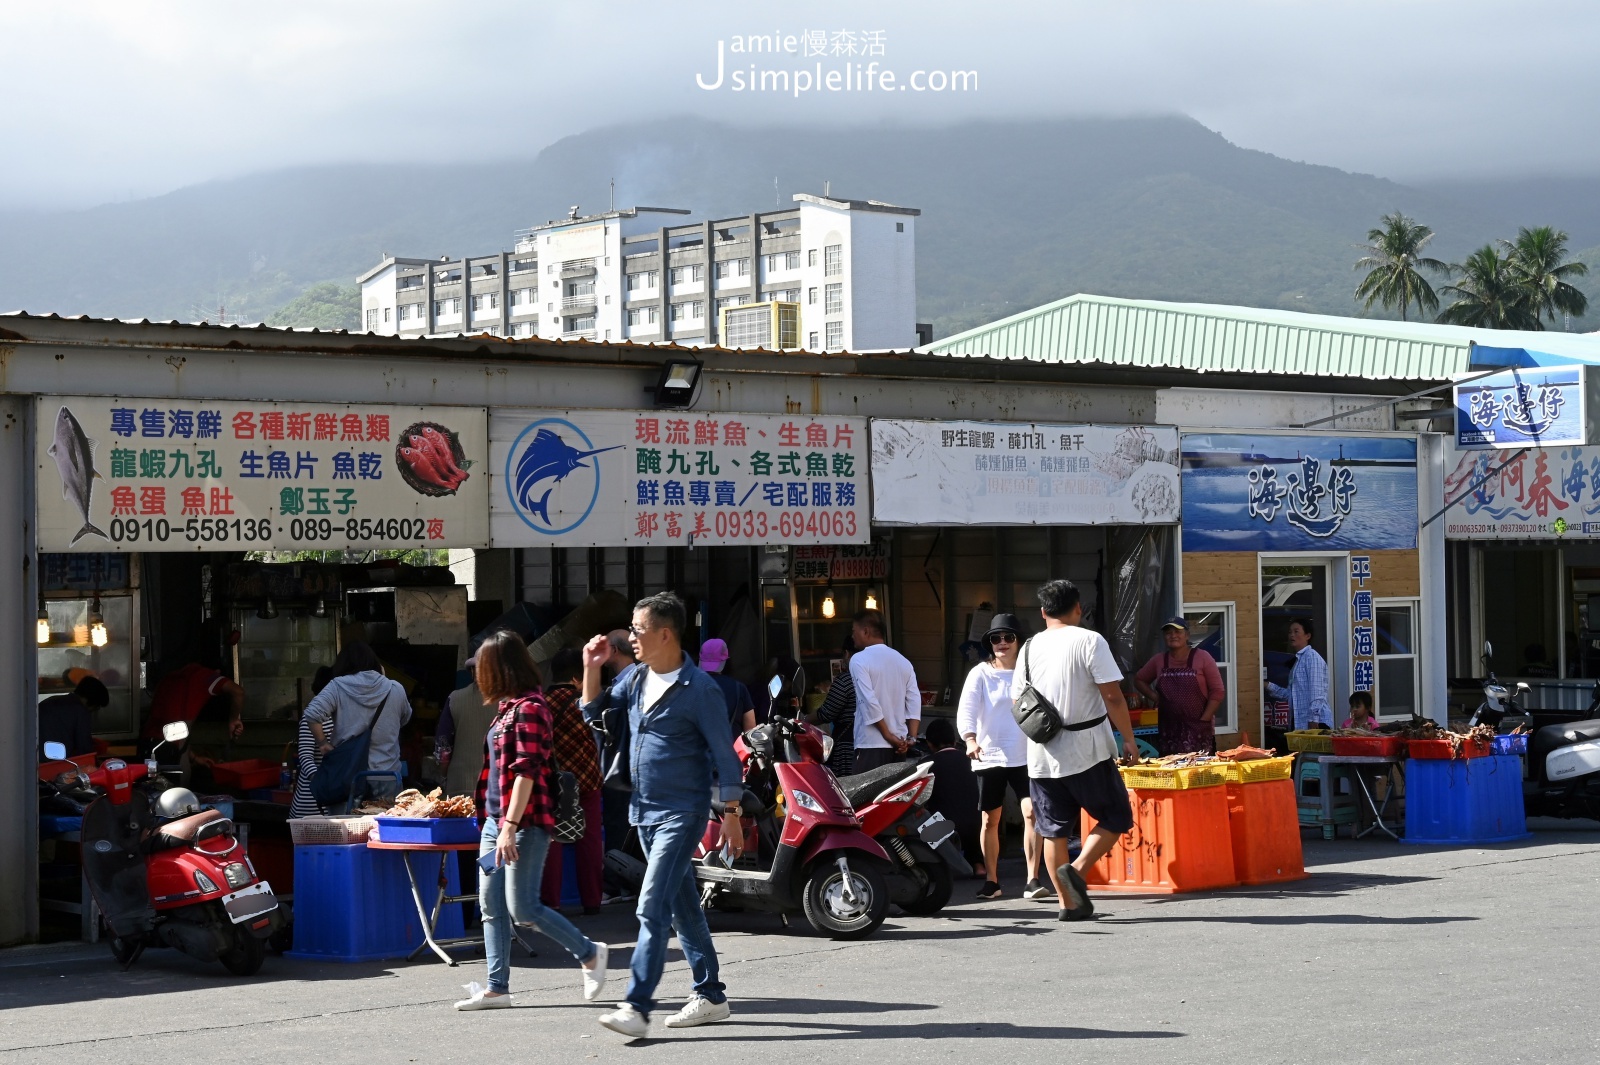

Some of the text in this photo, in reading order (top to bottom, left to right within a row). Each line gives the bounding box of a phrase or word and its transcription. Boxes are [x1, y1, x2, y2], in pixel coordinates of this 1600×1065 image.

[110, 407, 391, 443] 專售海鮮 各種新鮮魚類
[1470, 382, 1565, 435] 海邊仔
[635, 417, 855, 450] 現流鮮魚、生魚片
[110, 448, 383, 481] 龍蝦九孔 生魚片 魚乾
[636, 448, 856, 478] 醃九孔、各式魚乾
[110, 486, 358, 517] 魚蛋 魚肚 鄭玉子
[1248, 455, 1356, 537] 海邊仔
[1351, 556, 1374, 691] 平價海鮮
